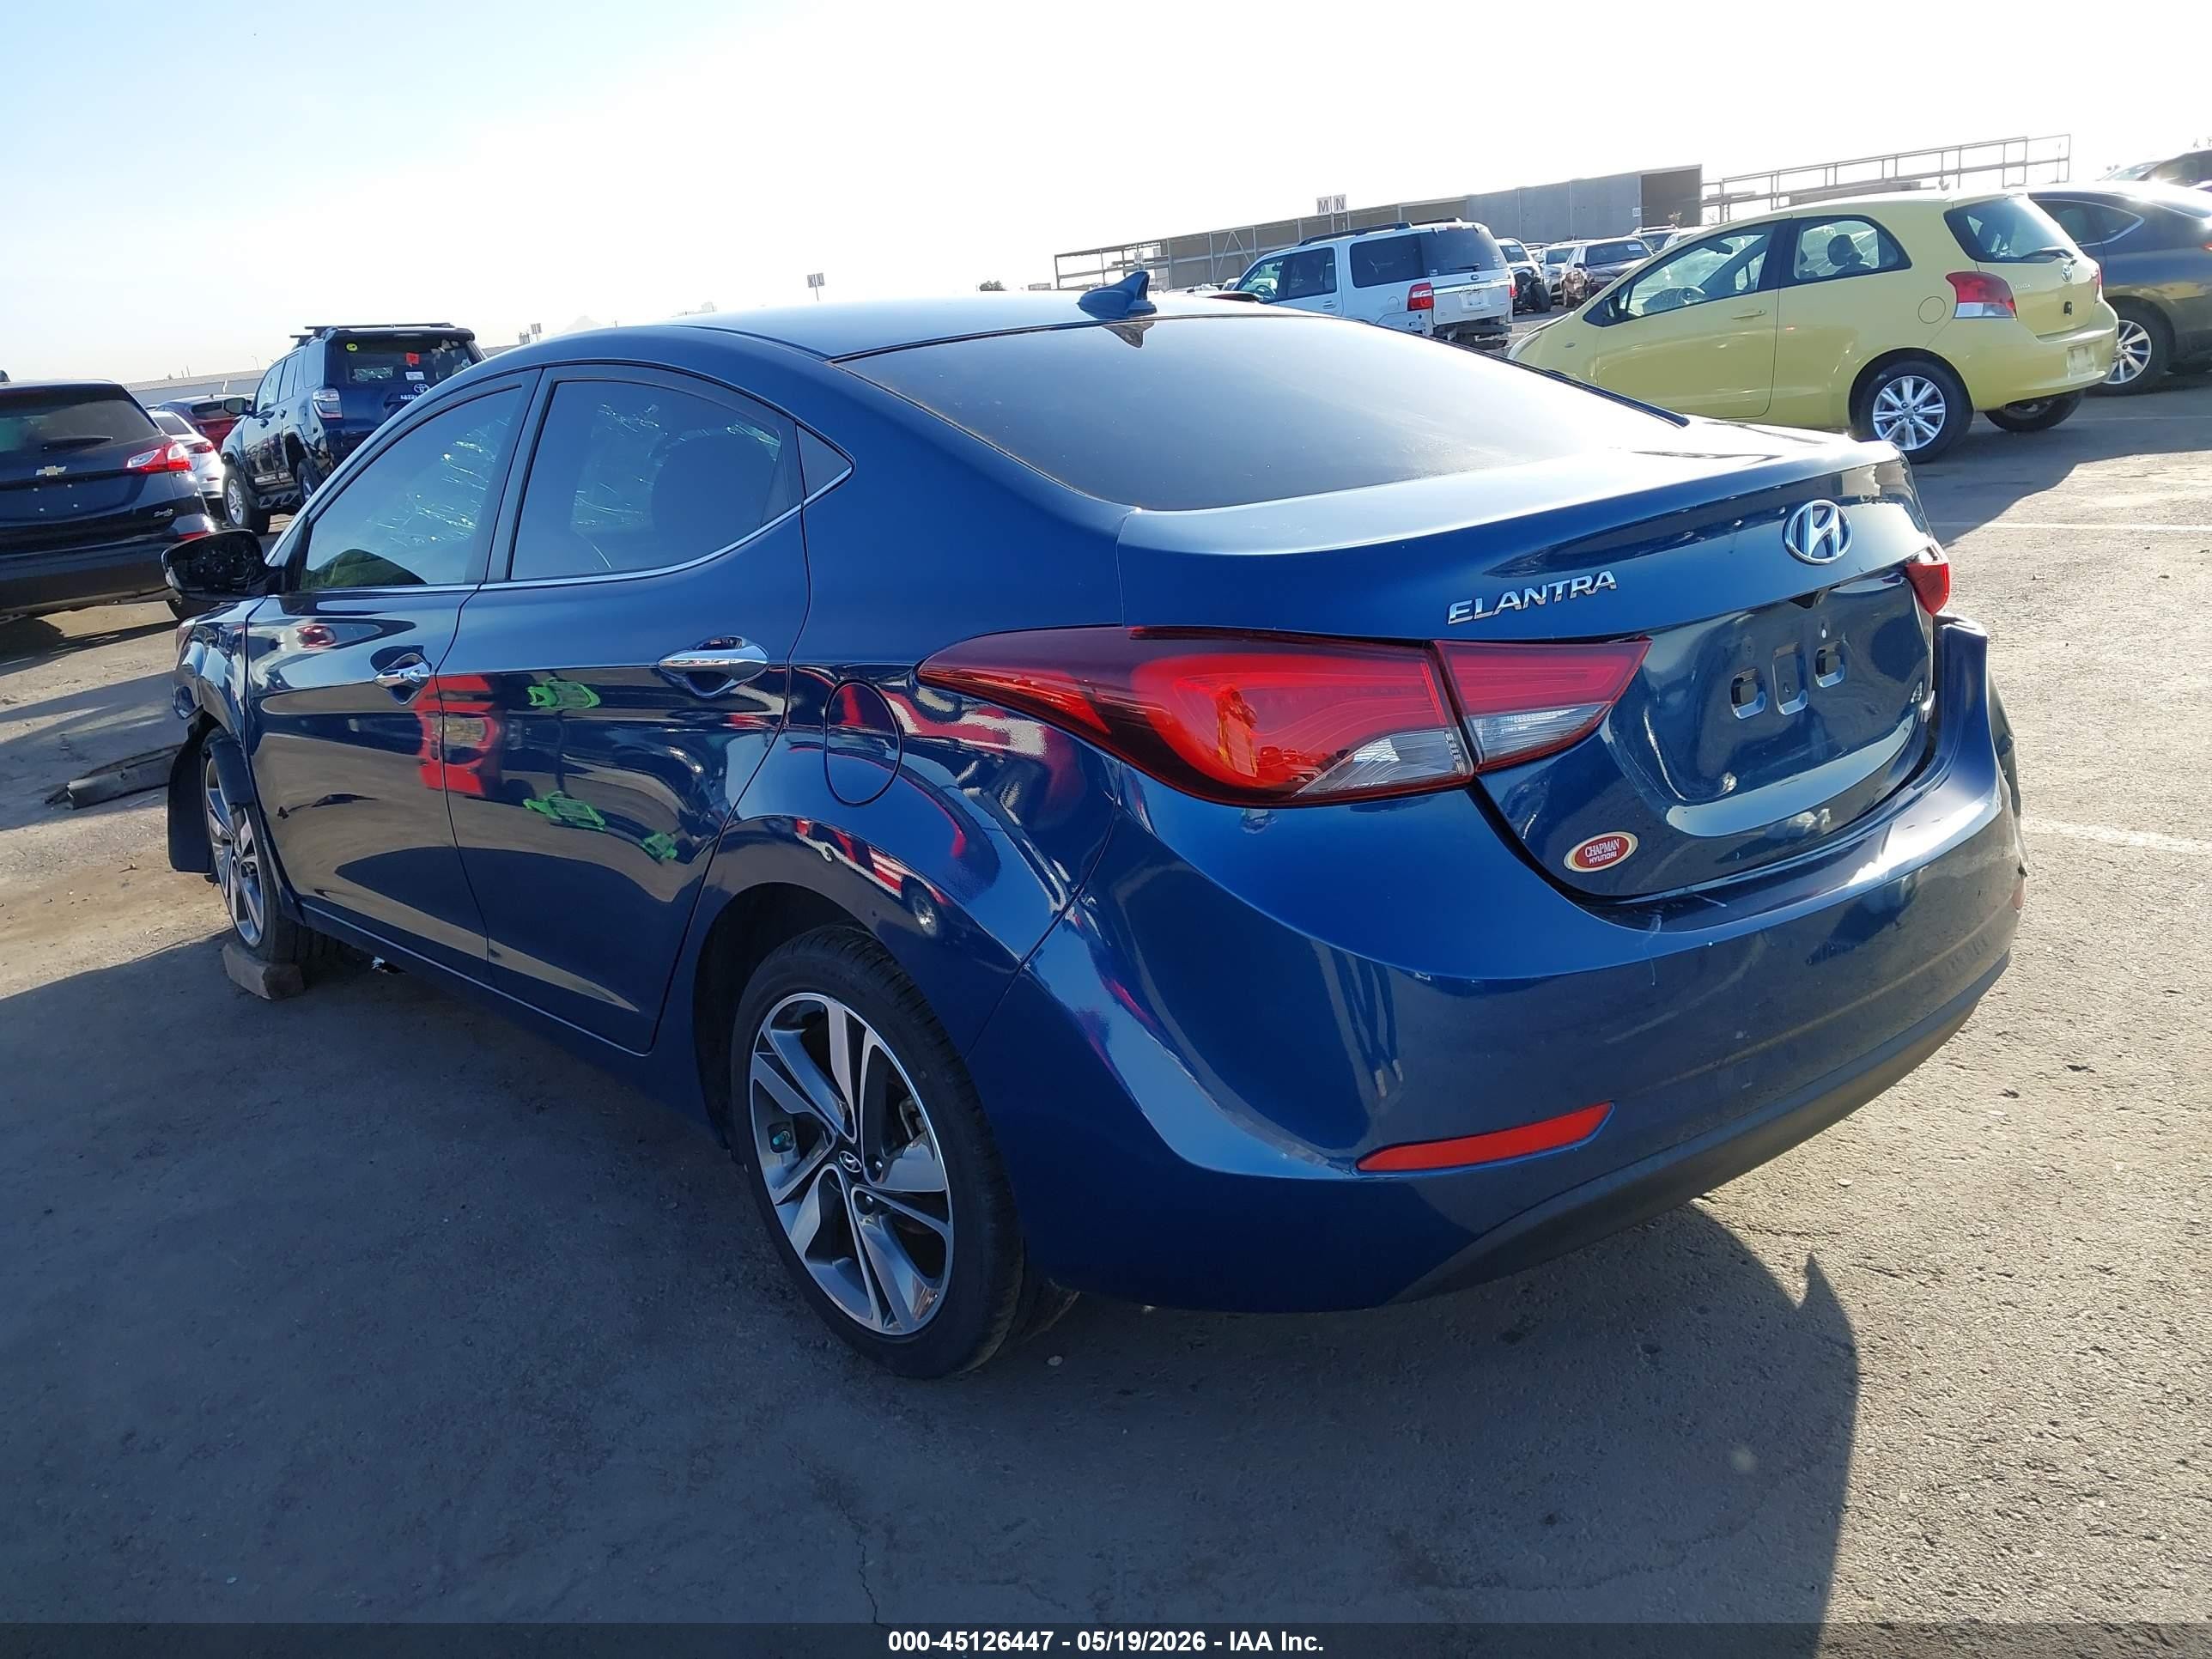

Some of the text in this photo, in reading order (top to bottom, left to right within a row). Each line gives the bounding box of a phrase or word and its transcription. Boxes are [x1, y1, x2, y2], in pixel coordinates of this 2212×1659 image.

[1318, 200, 1328, 214] M
[1336, 198, 1345, 211] N
[1448, 570, 1618, 625] ELANTRA
[1584, 838, 1620, 858] CHAPMAN
[1589, 851, 1618, 865] HYUNDAI
